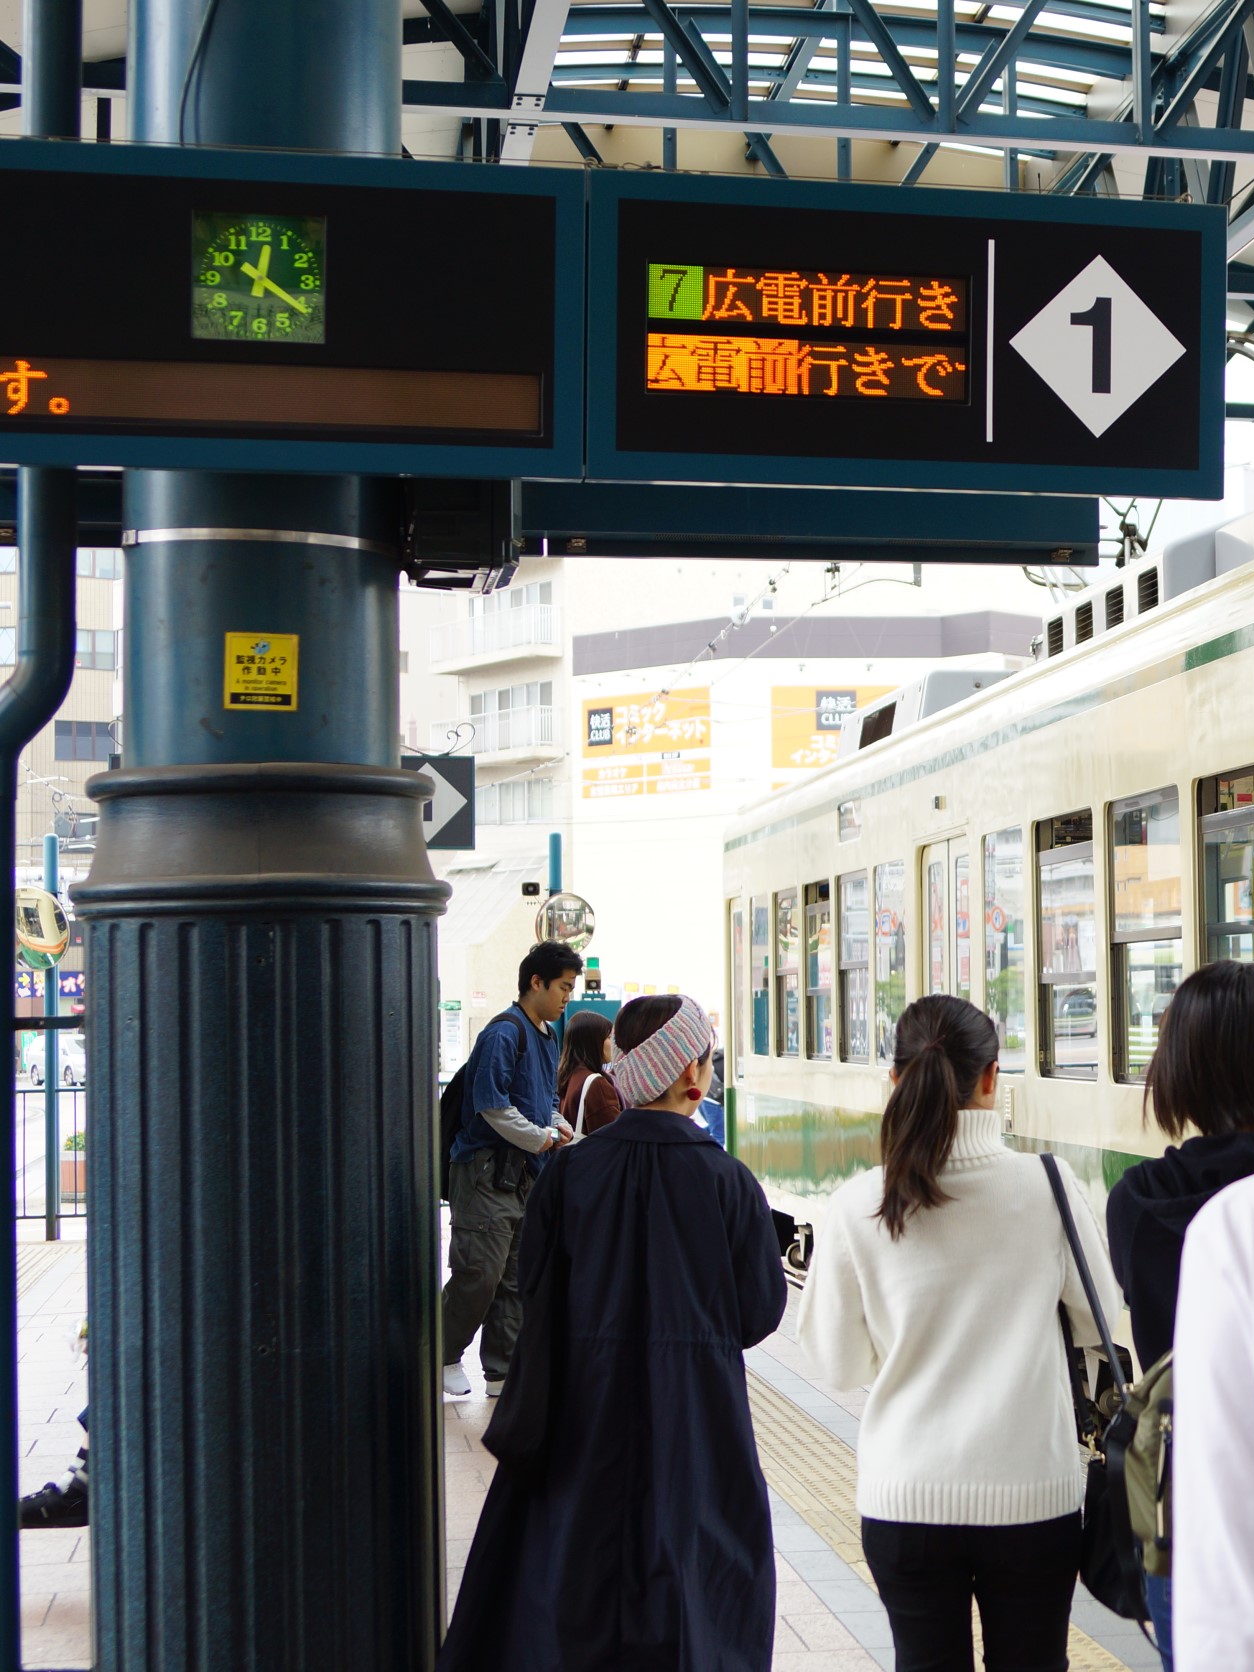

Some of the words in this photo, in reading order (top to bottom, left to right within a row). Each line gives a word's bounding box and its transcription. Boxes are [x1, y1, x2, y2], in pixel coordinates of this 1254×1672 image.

[249, 227, 272, 241] 12
[228, 235, 248, 250] 11
[280, 235, 290, 250] 1
[212, 252, 235, 266] 10
[293, 253, 309, 268] 2
[205, 271, 221, 285] 9
[300, 275, 315, 290] 3
[212, 293, 228, 308] 8
[660, 268, 688, 312] 7
[702, 269, 958, 330] 広電前行き
[229, 311, 244, 326] 7
[252, 318, 267, 333] 6
[275, 313, 291, 328] 5
[1070, 297, 1112, 394] 1
[648, 336, 966, 396] 広電前行きで
[0, 360, 70, 415] す。
[235, 655, 287, 665] 監視カメラ
[241, 666, 281, 676] 作動中
[615, 702, 667, 723] コミック
[821, 713, 852, 725] CLU
[590, 713, 611, 729] 快活
[590, 728, 611, 741] CLUB
[615, 718, 707, 745] インターネット
[811, 735, 839, 749] コミ
